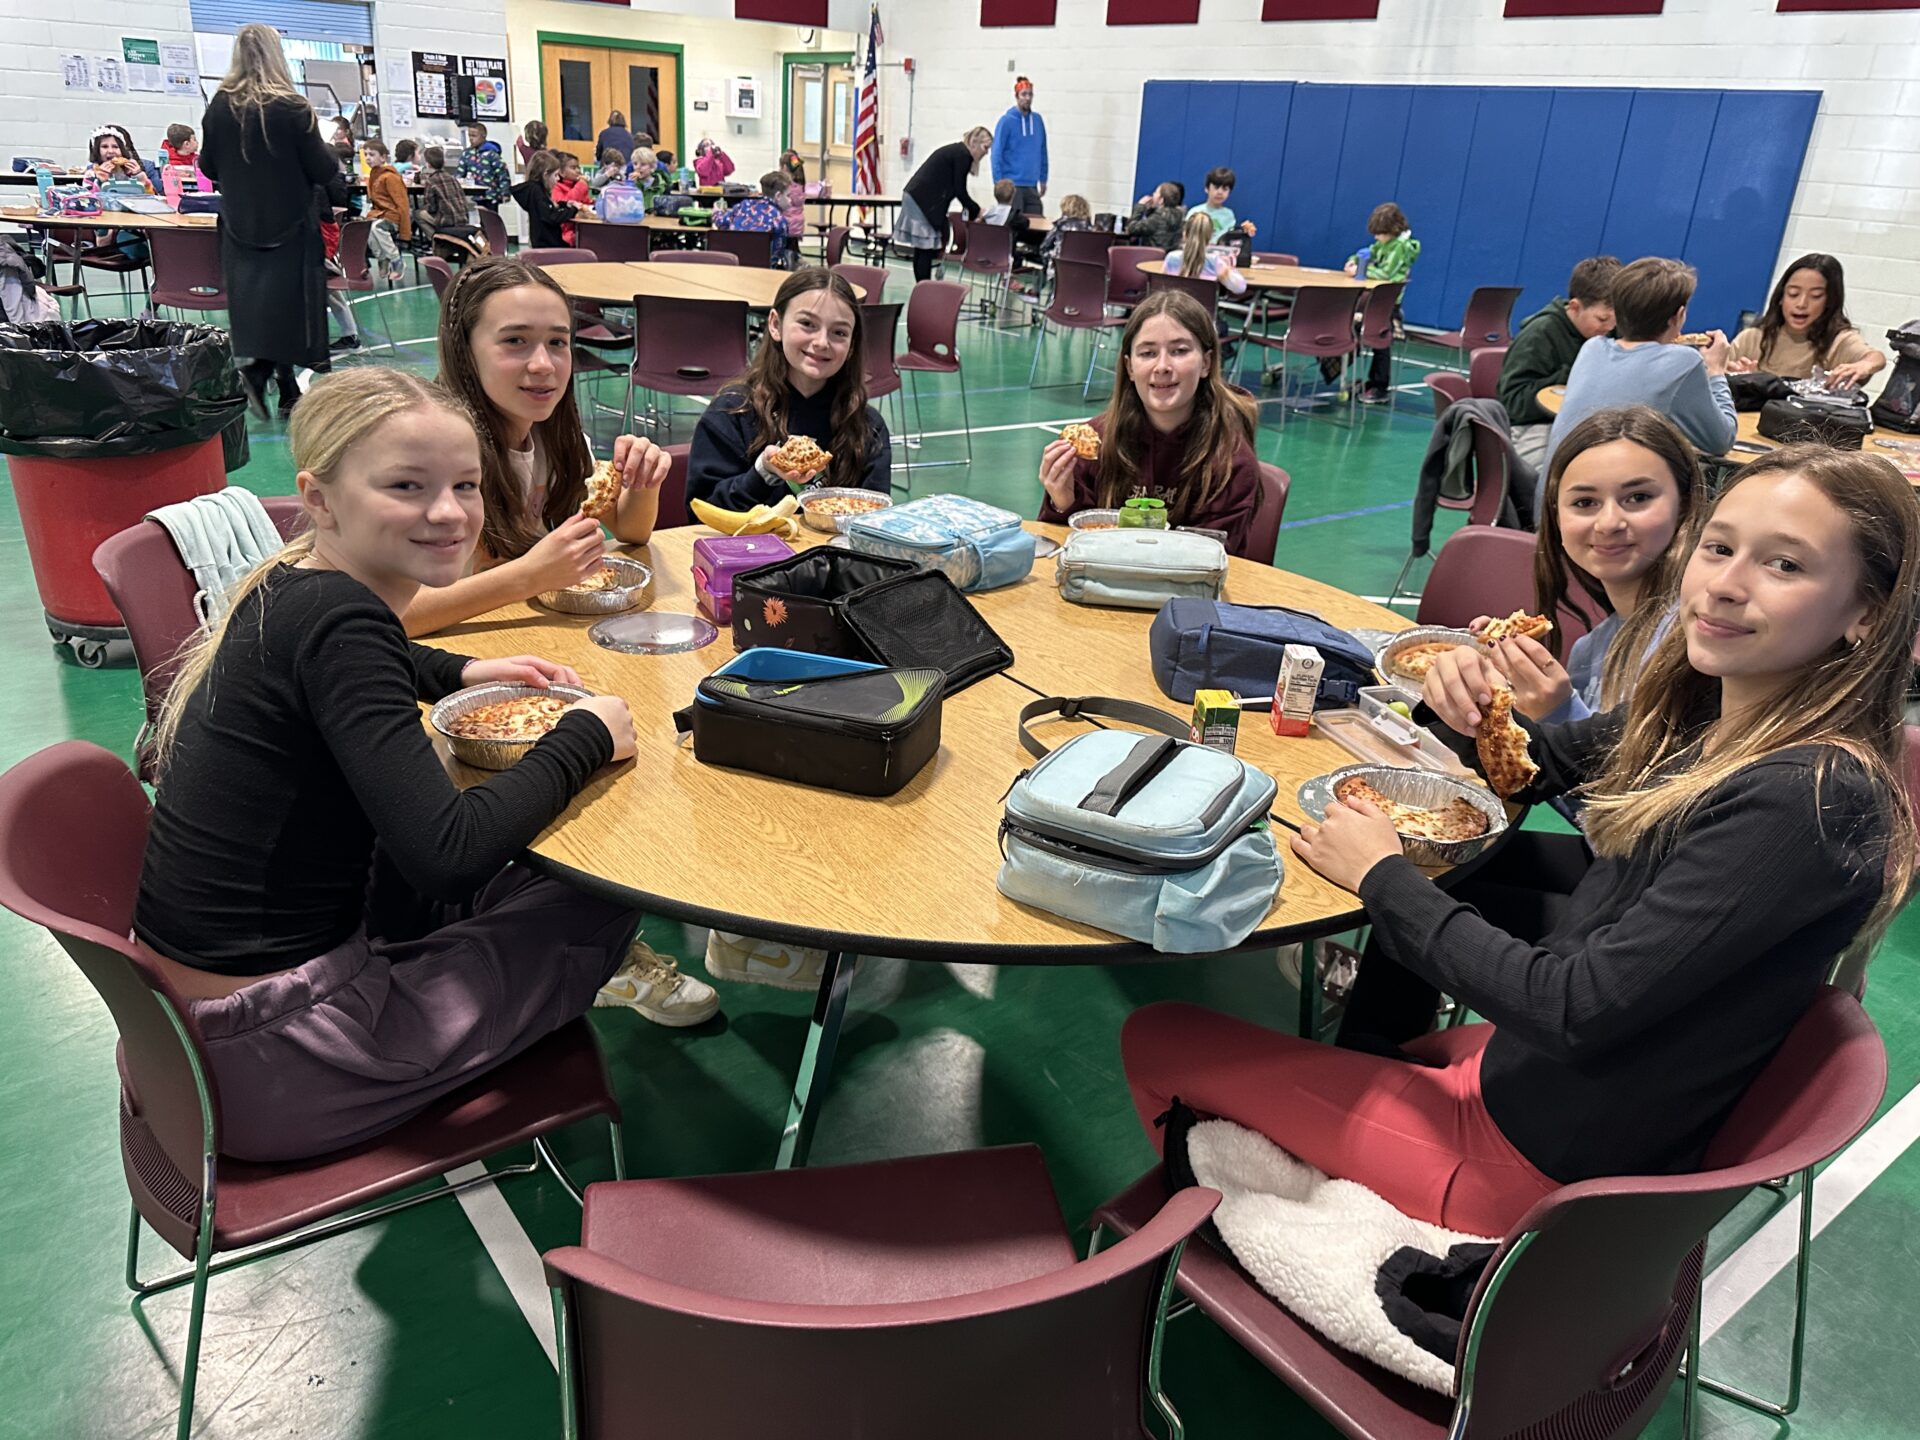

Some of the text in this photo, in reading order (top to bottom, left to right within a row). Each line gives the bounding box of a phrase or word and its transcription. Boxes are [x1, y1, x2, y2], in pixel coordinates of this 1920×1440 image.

[465, 59, 503, 70] GET YOUR PLATE
[473, 68, 489, 77] SHAPE!
